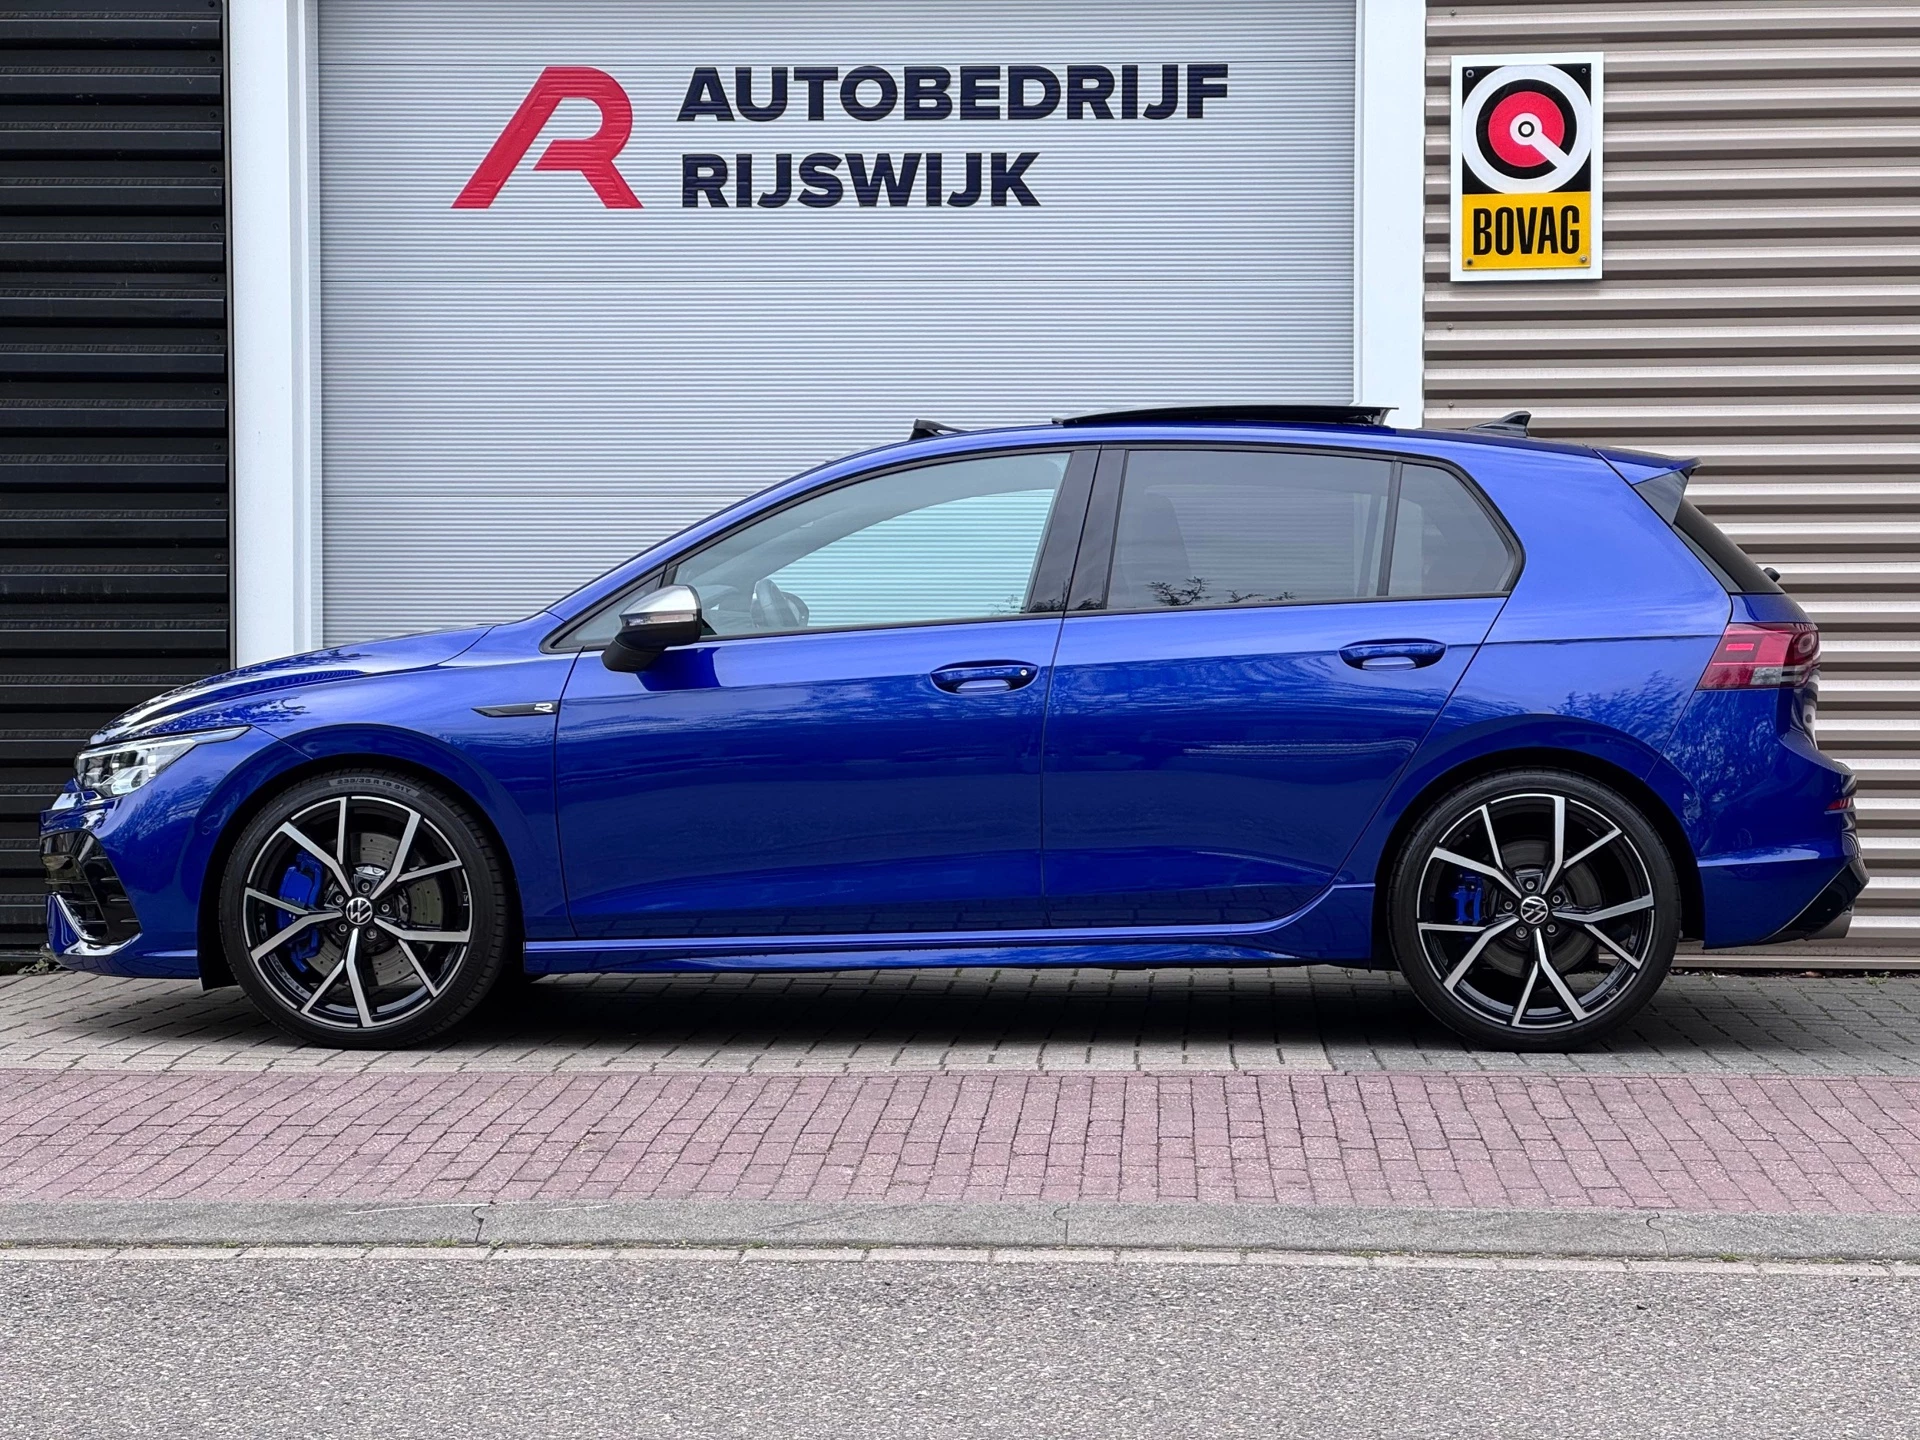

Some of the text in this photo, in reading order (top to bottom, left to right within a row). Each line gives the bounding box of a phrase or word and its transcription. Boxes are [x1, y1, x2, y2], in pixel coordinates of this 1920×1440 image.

[676, 63, 1229, 122] AUTOBEDRIJF
[681, 151, 1041, 209] RIJSWIJK
[1473, 204, 1580, 256] BOVAG
[534, 703, 554, 713] R
